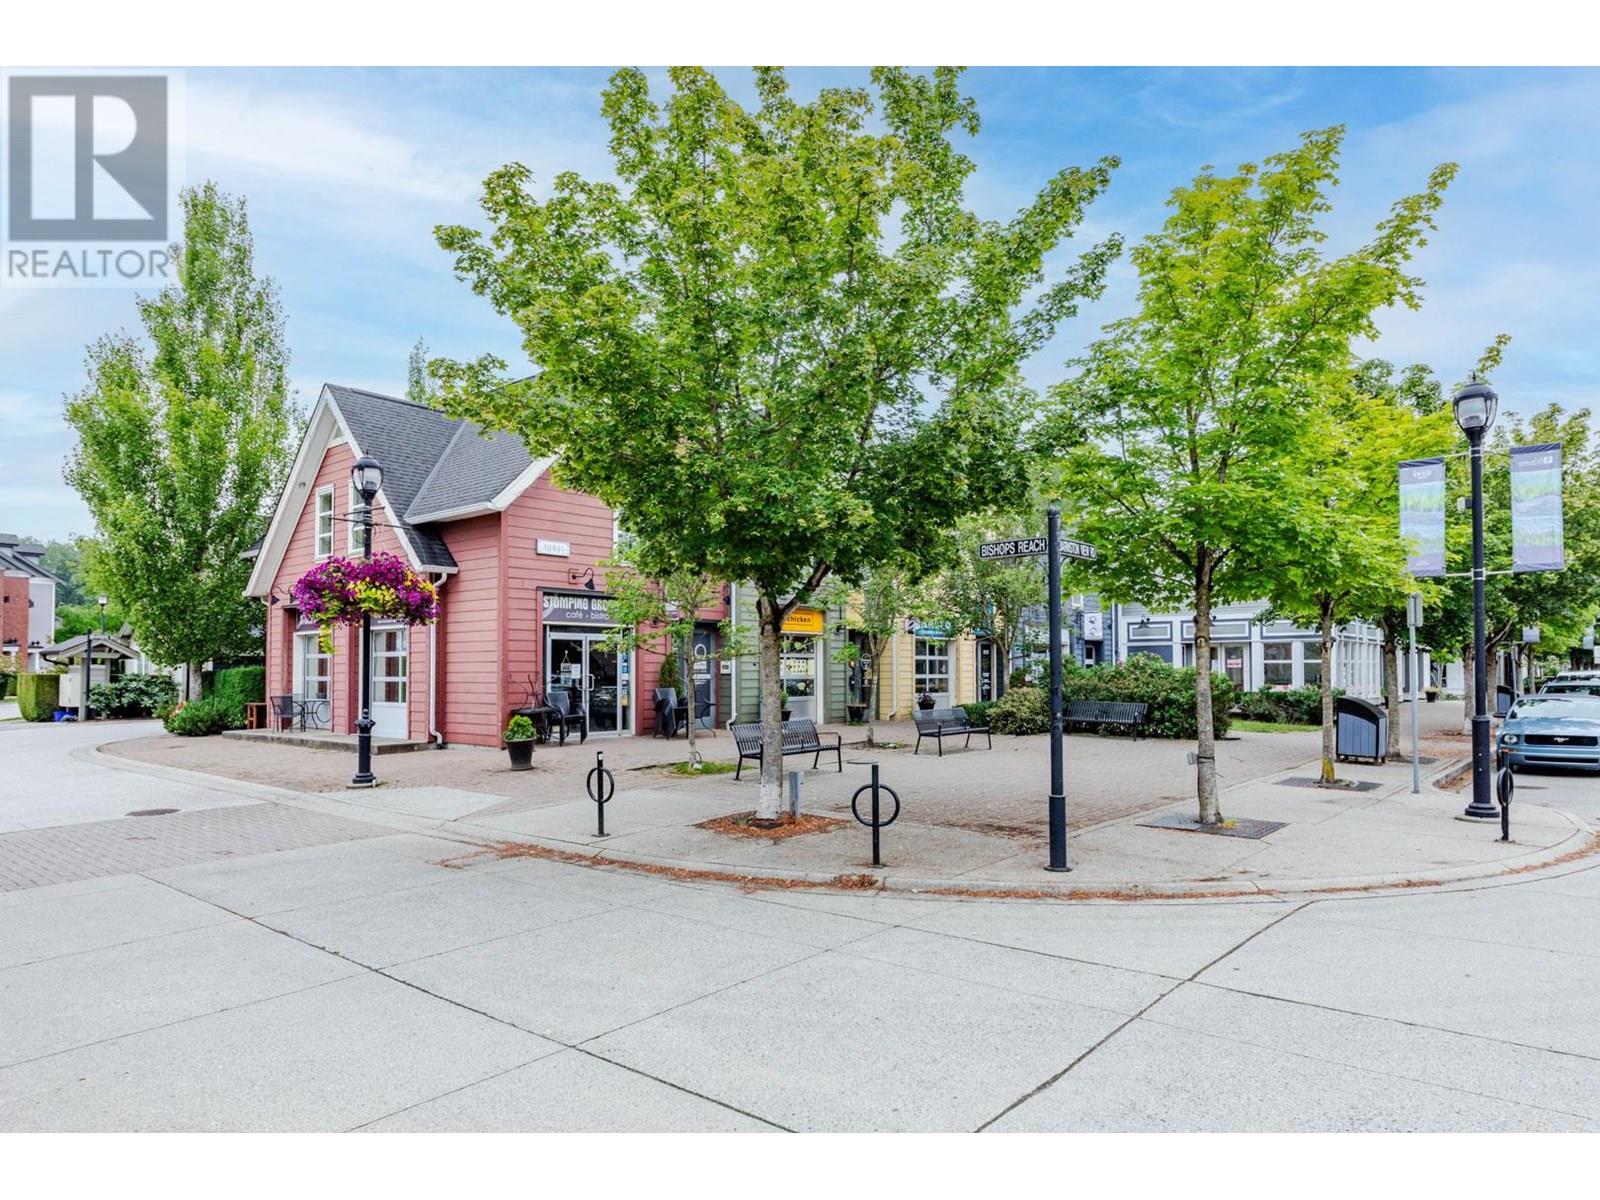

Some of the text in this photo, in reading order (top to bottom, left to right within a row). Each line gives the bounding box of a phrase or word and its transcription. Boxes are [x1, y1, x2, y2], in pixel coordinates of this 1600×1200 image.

[981, 539, 1045, 557] BISHOPS REACH
[543, 595, 588, 610] STOMPING
[566, 610, 583, 619] café
